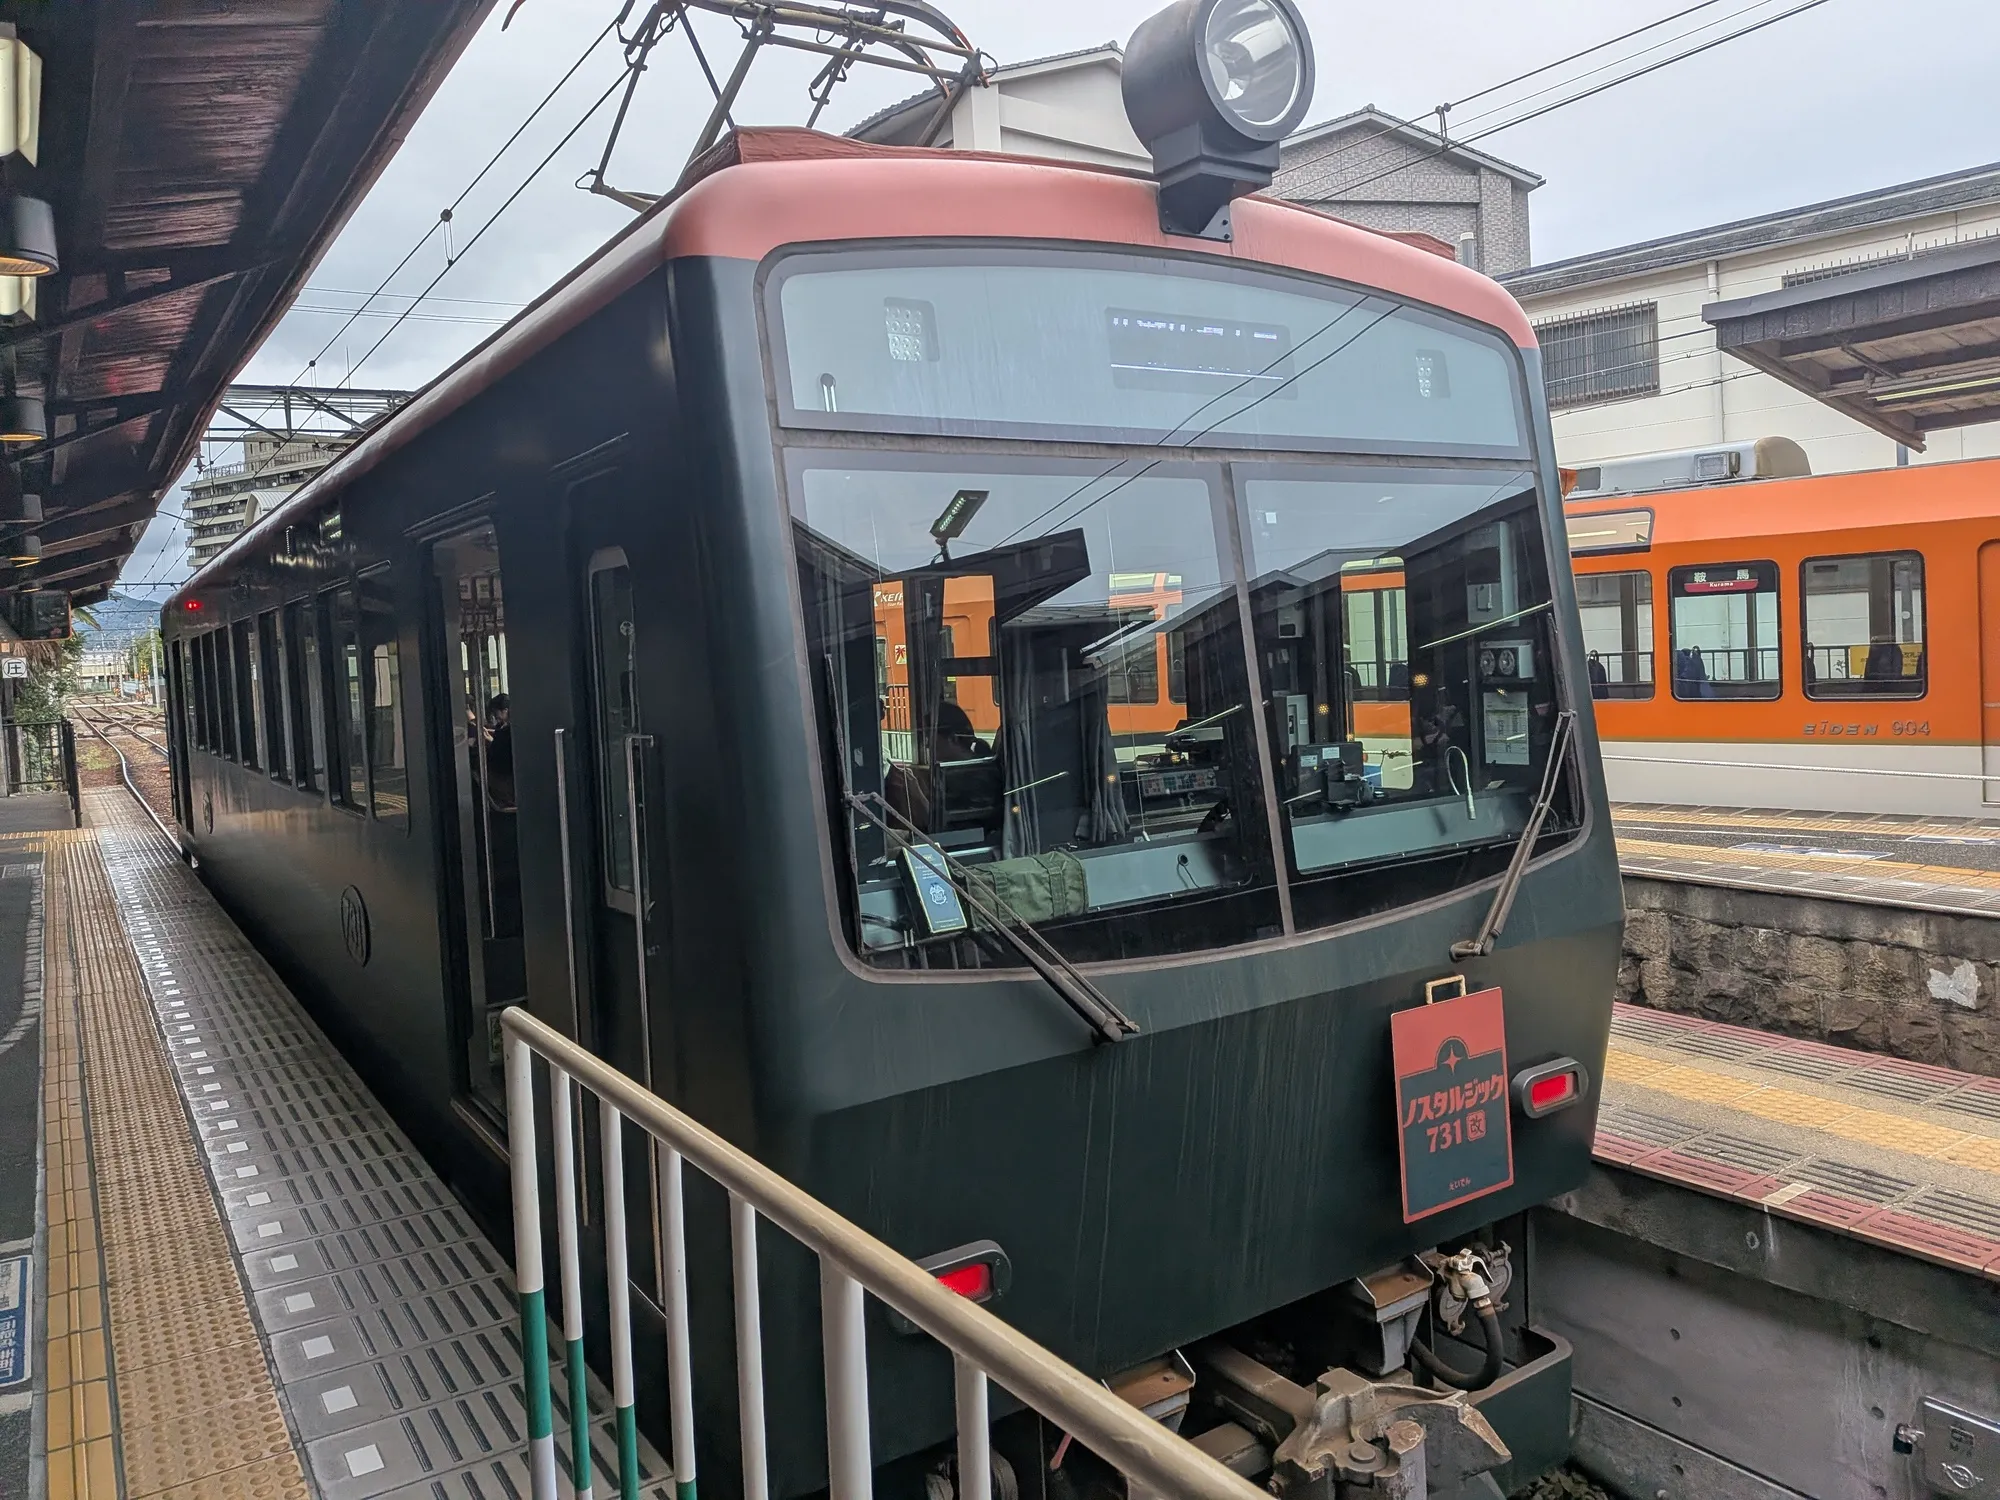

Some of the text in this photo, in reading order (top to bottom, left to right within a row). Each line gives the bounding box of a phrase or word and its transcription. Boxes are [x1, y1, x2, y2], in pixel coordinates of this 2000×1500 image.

[1892, 720, 1931, 736] 904
[1403, 1074, 1504, 1128] ノスタルジック
[1427, 1119, 1462, 1153] 731
